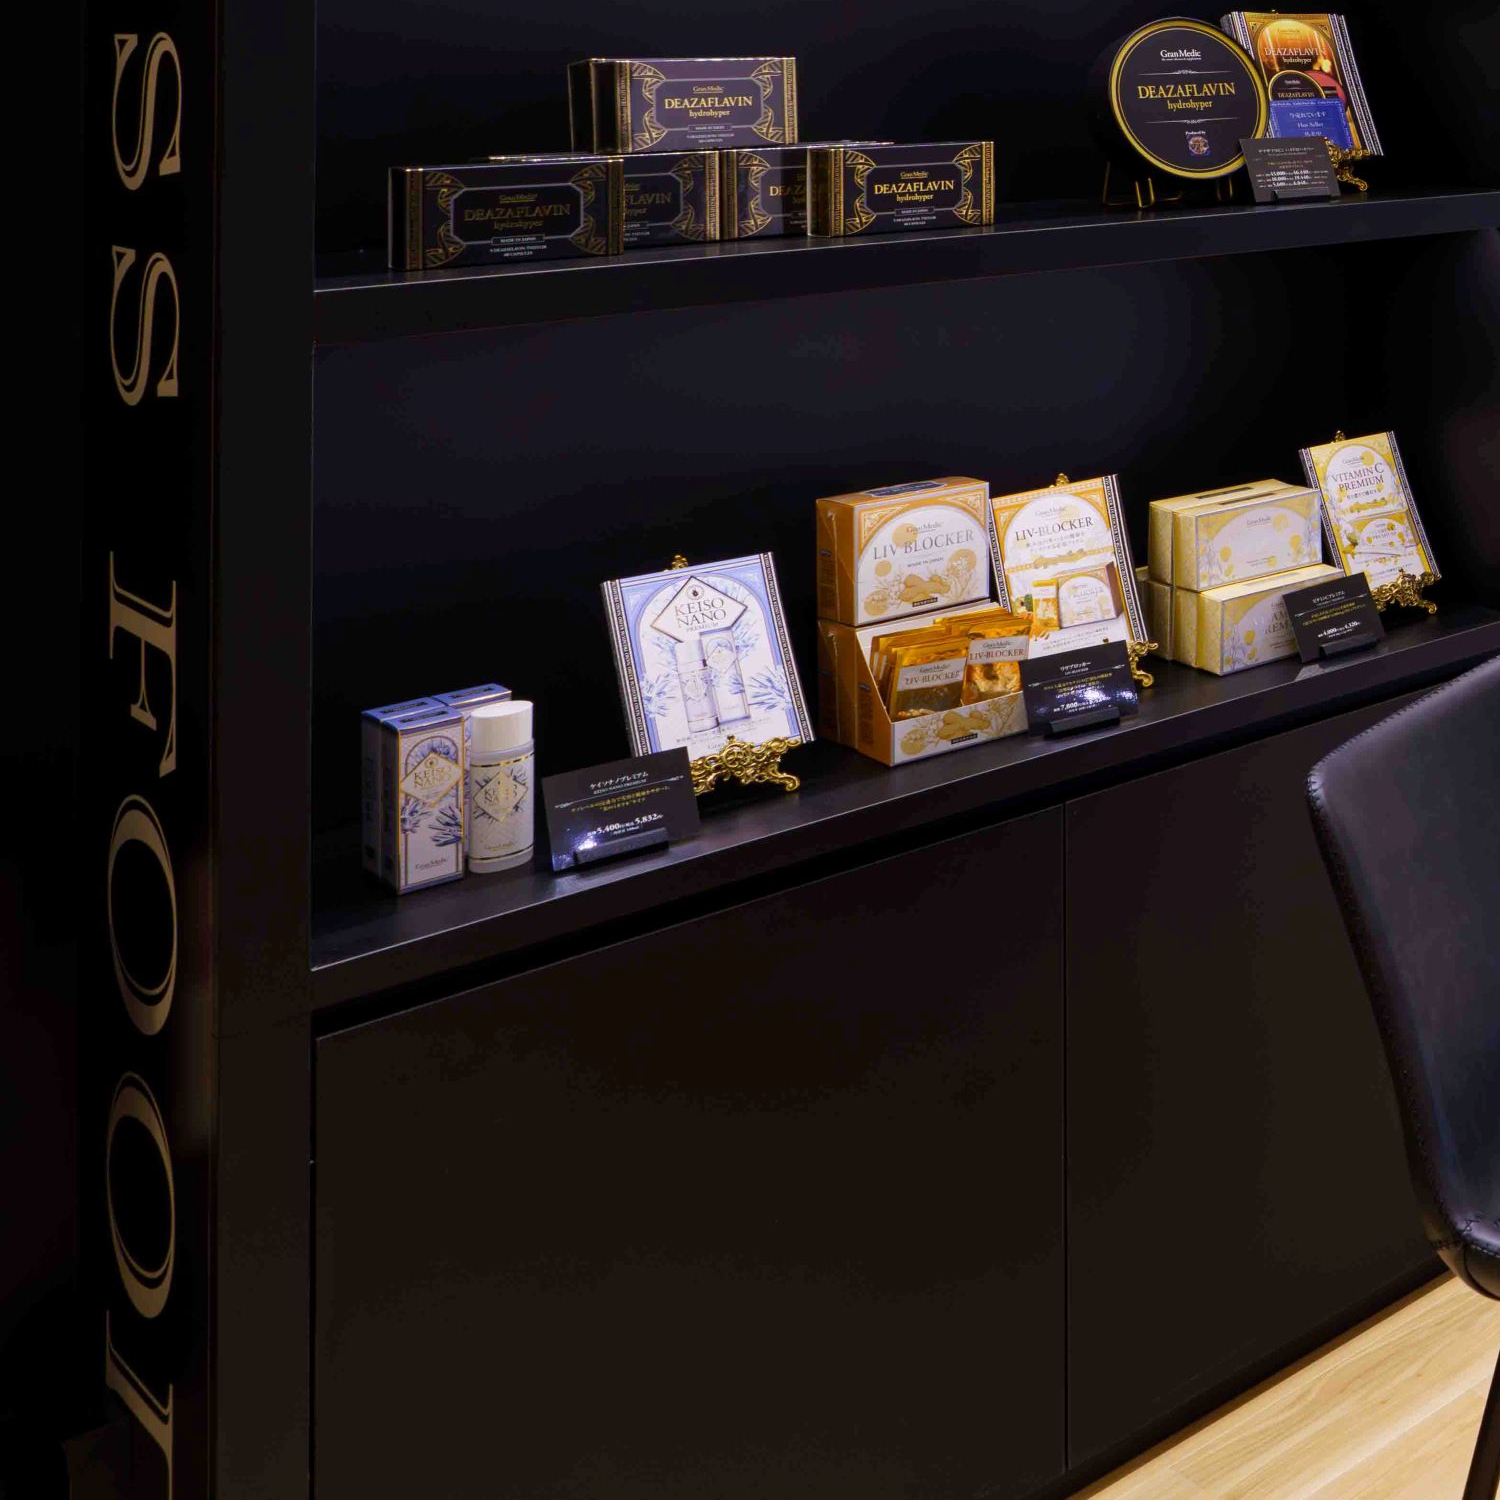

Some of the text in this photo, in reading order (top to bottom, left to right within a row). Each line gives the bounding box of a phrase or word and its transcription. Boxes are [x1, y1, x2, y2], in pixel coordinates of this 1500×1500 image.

[1265, 46, 1326, 57] DEAZAFLAVIN
[1283, 56, 1312, 64] hydrohyper
[1137, 82, 1236, 99] DEAZAFLAVIN
[664, 96, 753, 109] DEAZAFLAVIN
[1167, 99, 1212, 111] hydrohyper
[689, 109, 730, 118] hydrohyper
[874, 181, 954, 194] DEAZAFLAVIN
[897, 192, 933, 202] hydrohyper
[464, 204, 570, 220] DEAZAFLAVIN
[1332, 462, 1384, 484] VITAMIN C
[1338, 476, 1385, 492] PREMIUM
[1015, 517, 1093, 541] LIV-BLOCKER
[675, 598, 724, 616] KEISO
[677, 608, 727, 628] NANO
[970, 649, 1026, 661] LIV-BLOCKER
[906, 671, 960, 685] LIV-BLOCKER
[590, 771, 649, 789] ケイソナノプレミアム
